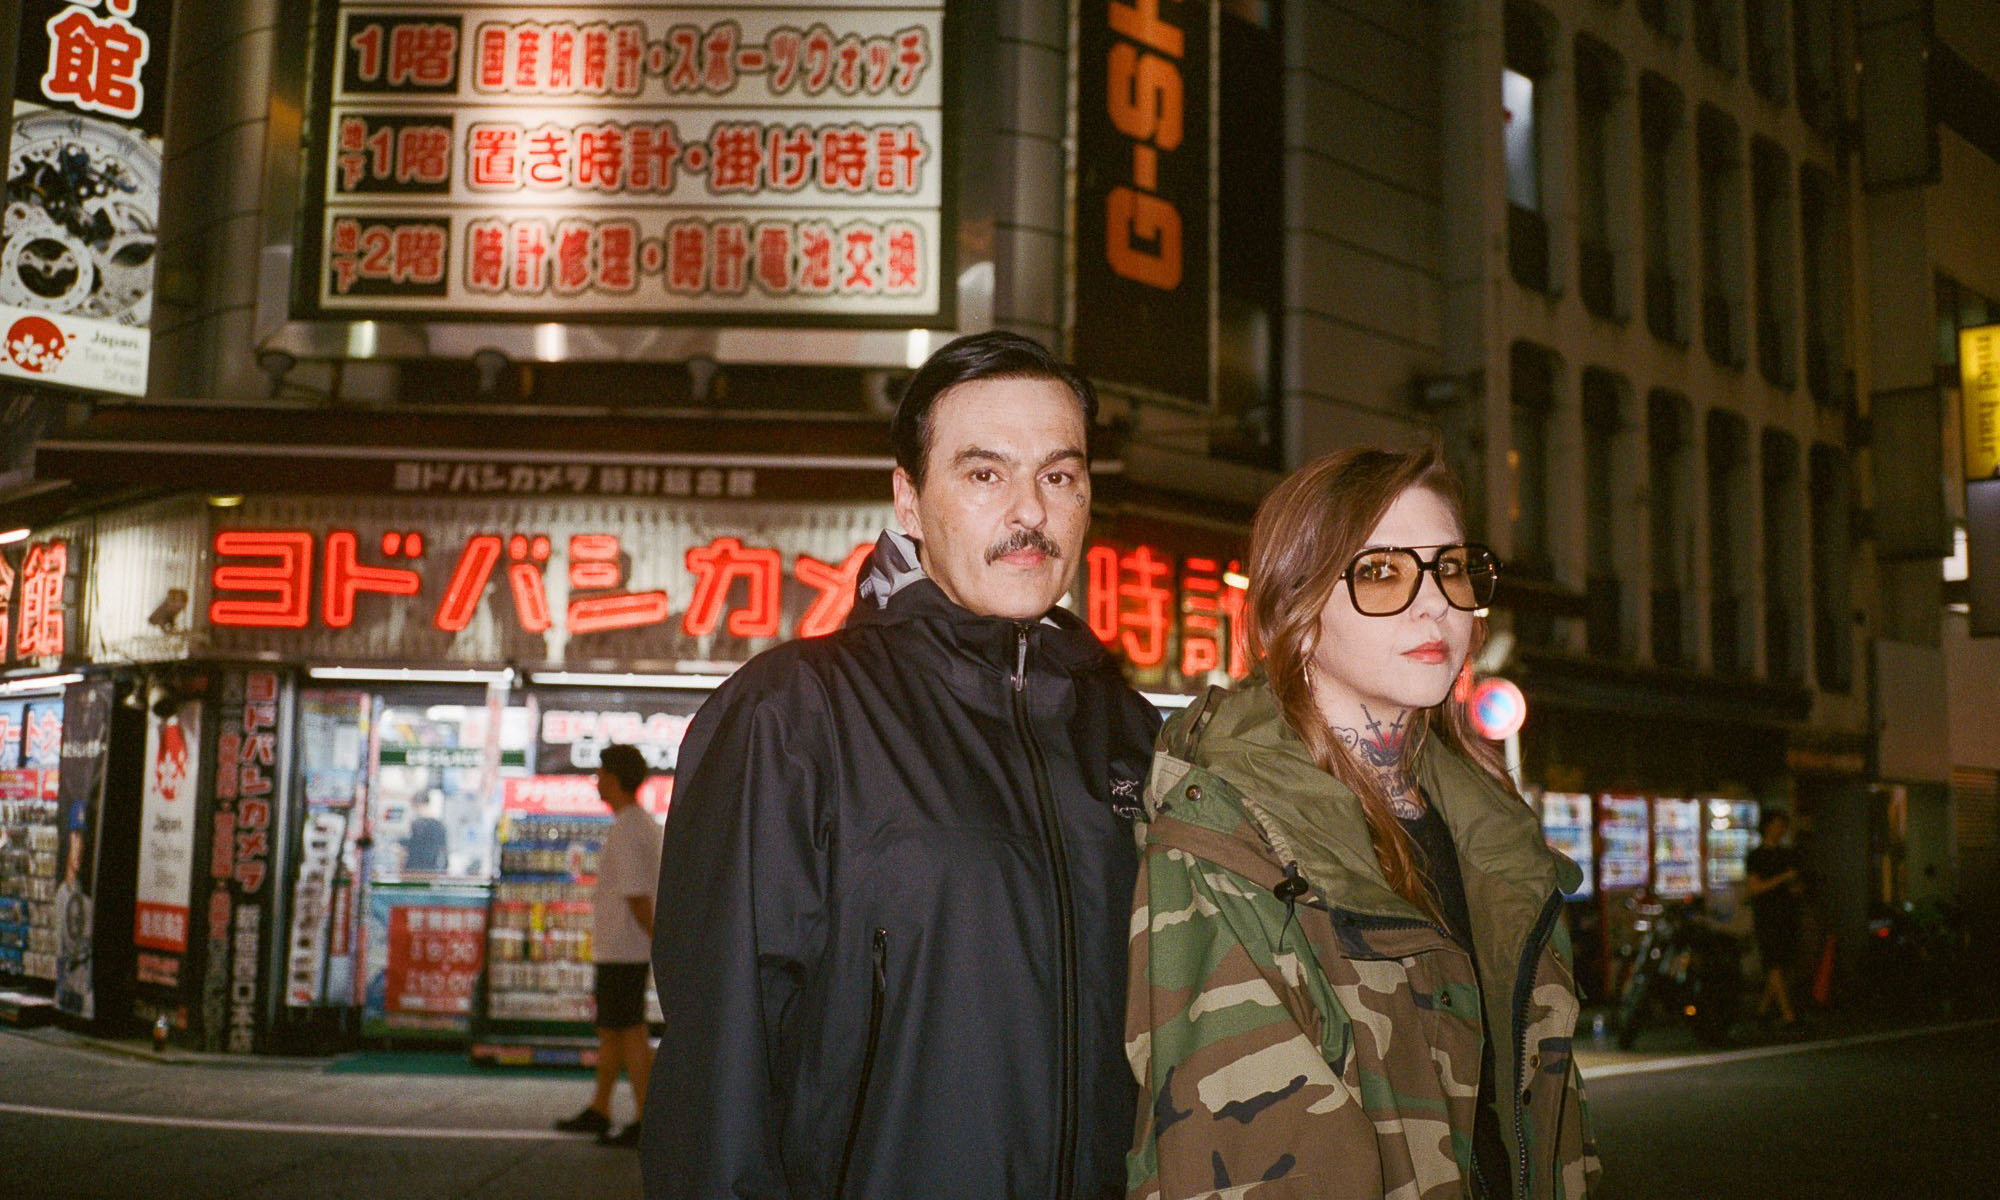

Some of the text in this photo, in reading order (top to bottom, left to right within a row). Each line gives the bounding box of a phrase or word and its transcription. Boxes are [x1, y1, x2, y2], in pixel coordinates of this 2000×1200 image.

[42, 0, 149, 118] 館
[351, 24, 457, 85] 1階
[472, 127, 922, 189] 置き時計・掛け時計
[473, 224, 920, 290] 時計修理・時計電池交換
[395, 461, 590, 491] ヨドバシカメラ
[236, 672, 277, 893] ヨドバシカメラ
